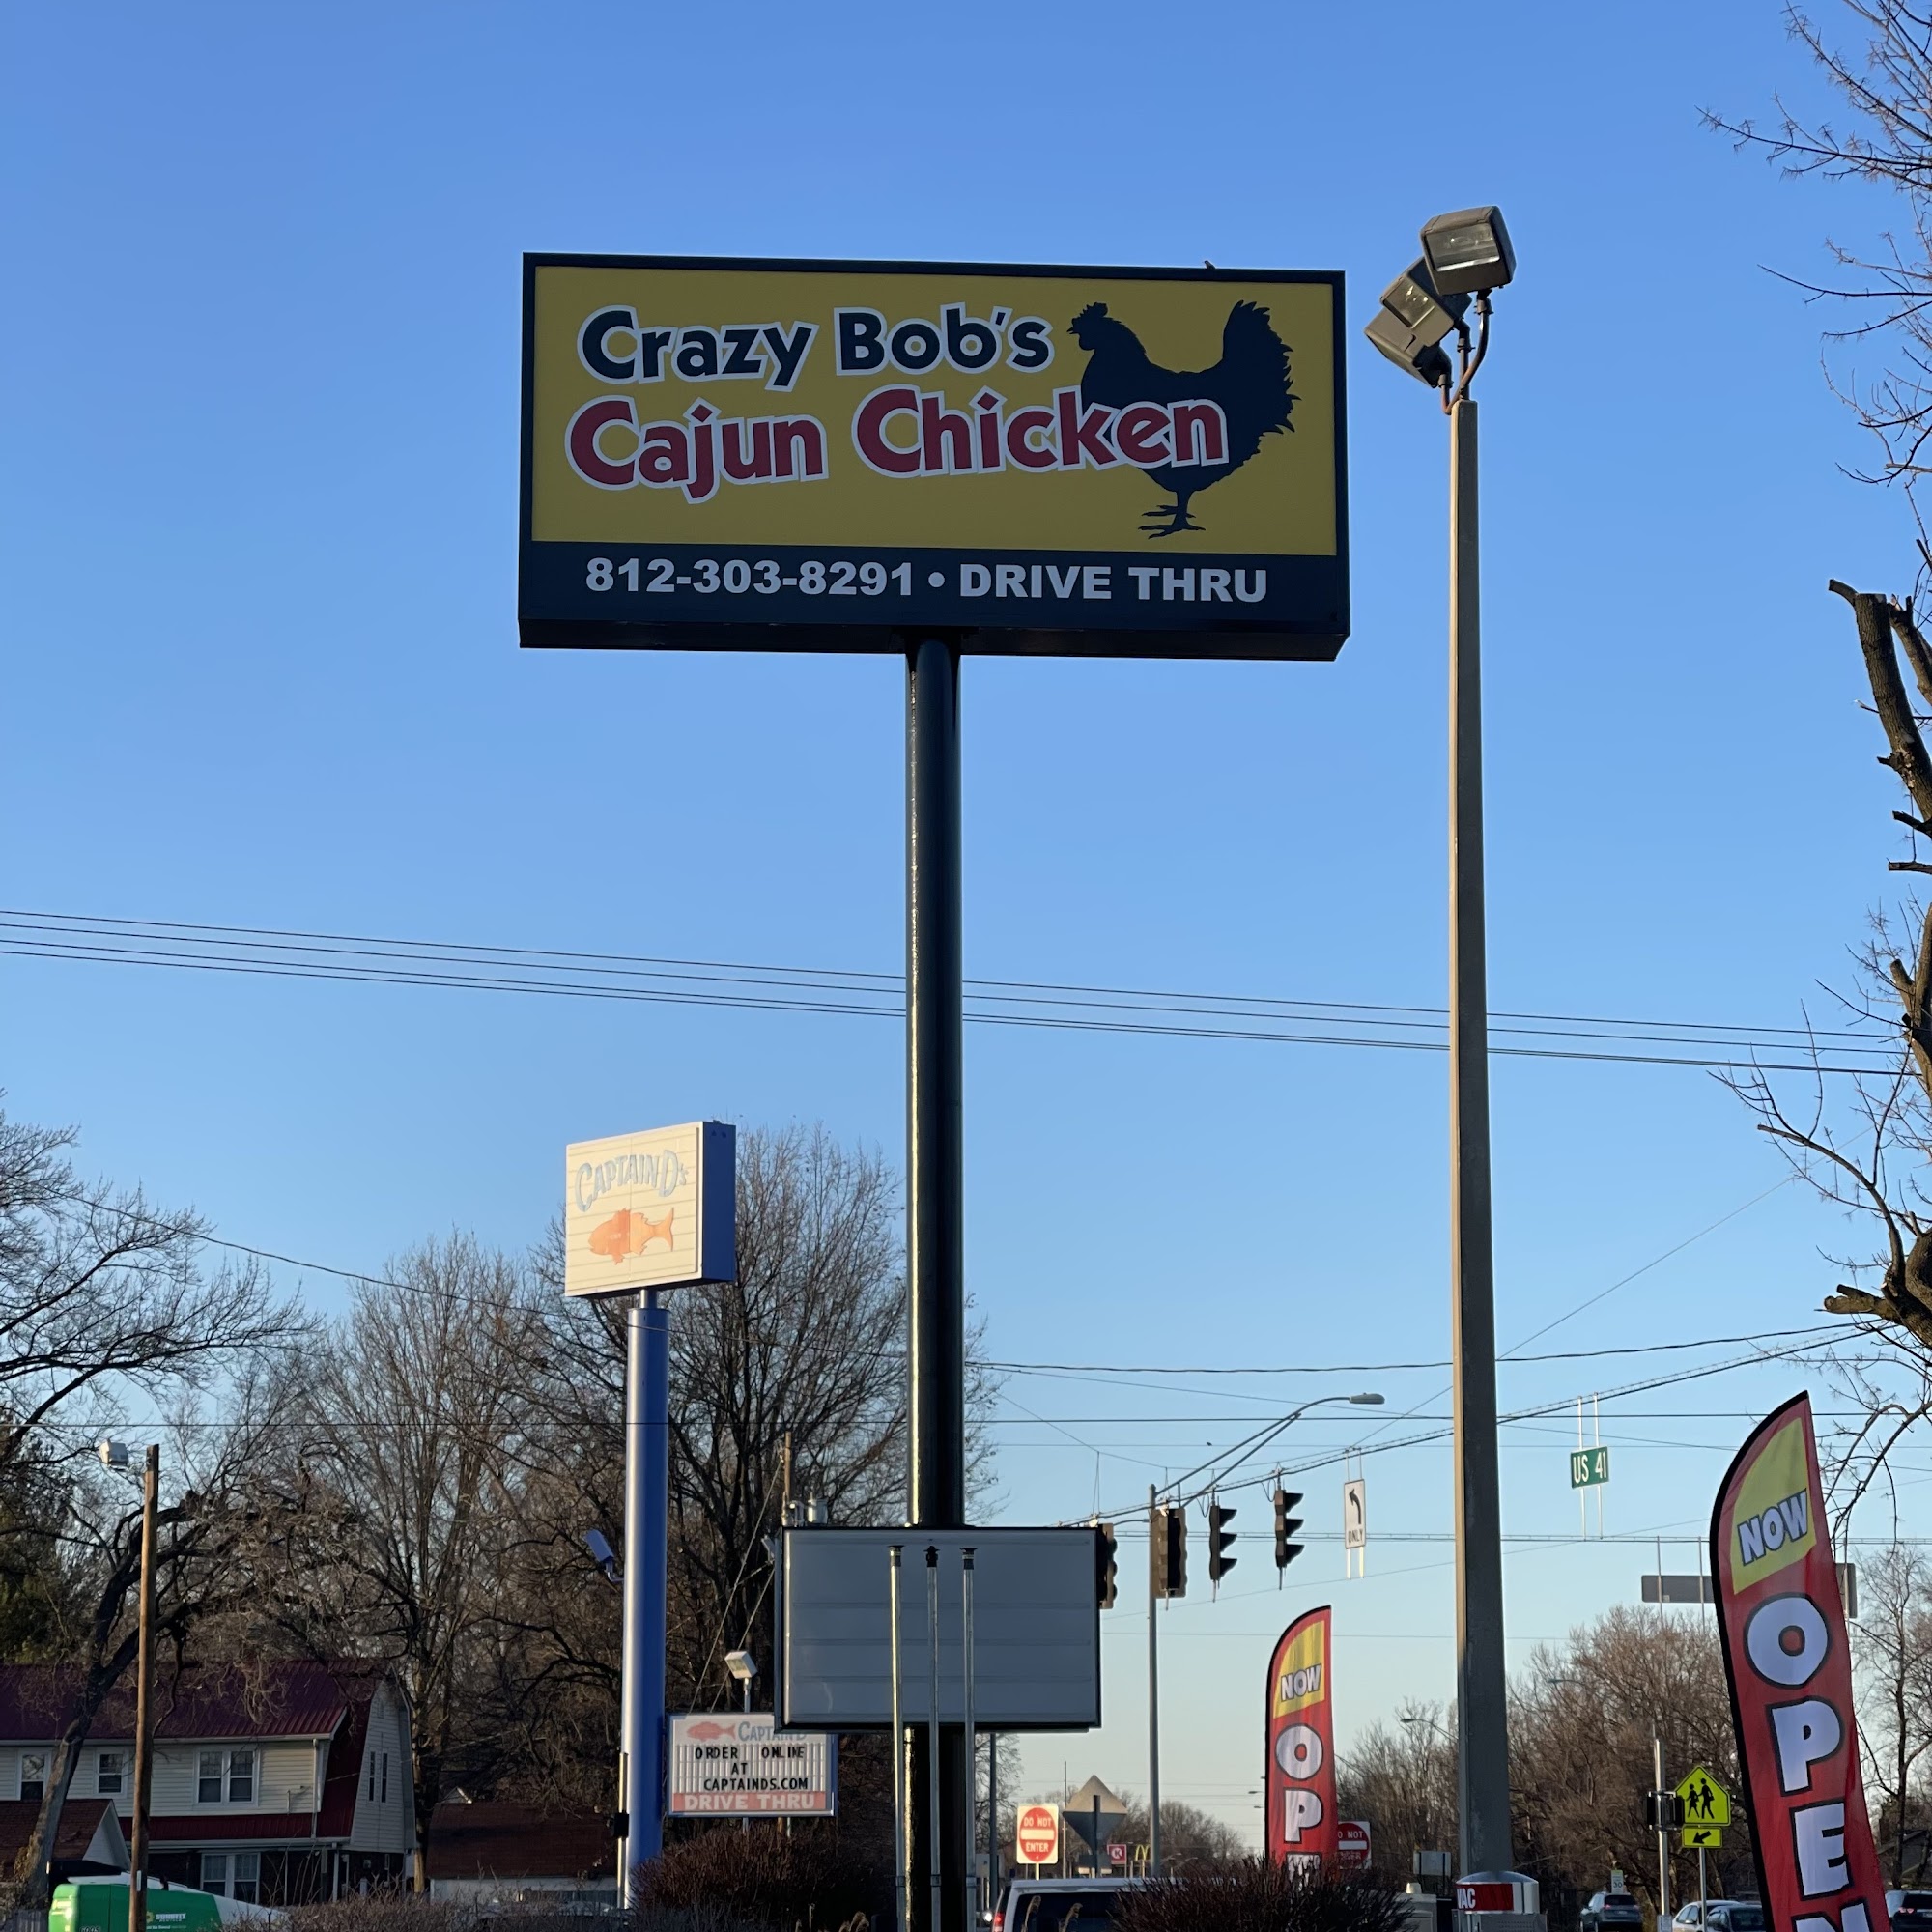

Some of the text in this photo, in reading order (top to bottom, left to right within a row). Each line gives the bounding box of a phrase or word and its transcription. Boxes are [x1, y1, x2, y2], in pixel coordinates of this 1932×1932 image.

[580, 302, 1055, 392] Crazy Bob's
[566, 384, 1229, 504] Cajun Chicken
[585, 557, 1268, 604] 812-303-8291 DRIVE THRU
[1573, 1450, 1607, 1484] US 41
[1738, 1488, 1808, 1566] NOW
[1348, 1528, 1363, 1545] ONLY
[1281, 1663, 1321, 1701] NOW
[695, 1747, 805, 1759] ORDER ONLINE
[731, 1763, 748, 1775] AT
[703, 1778, 809, 1791] CAPTAINDS.COM
[684, 1794, 815, 1810] DRIVE THRU
[1024, 1817, 1052, 1827] DO NOT
[1347, 1831, 1364, 1839] NOT
[1026, 1842, 1049, 1852] ENTER
[1457, 1888, 1476, 1909] VAC
